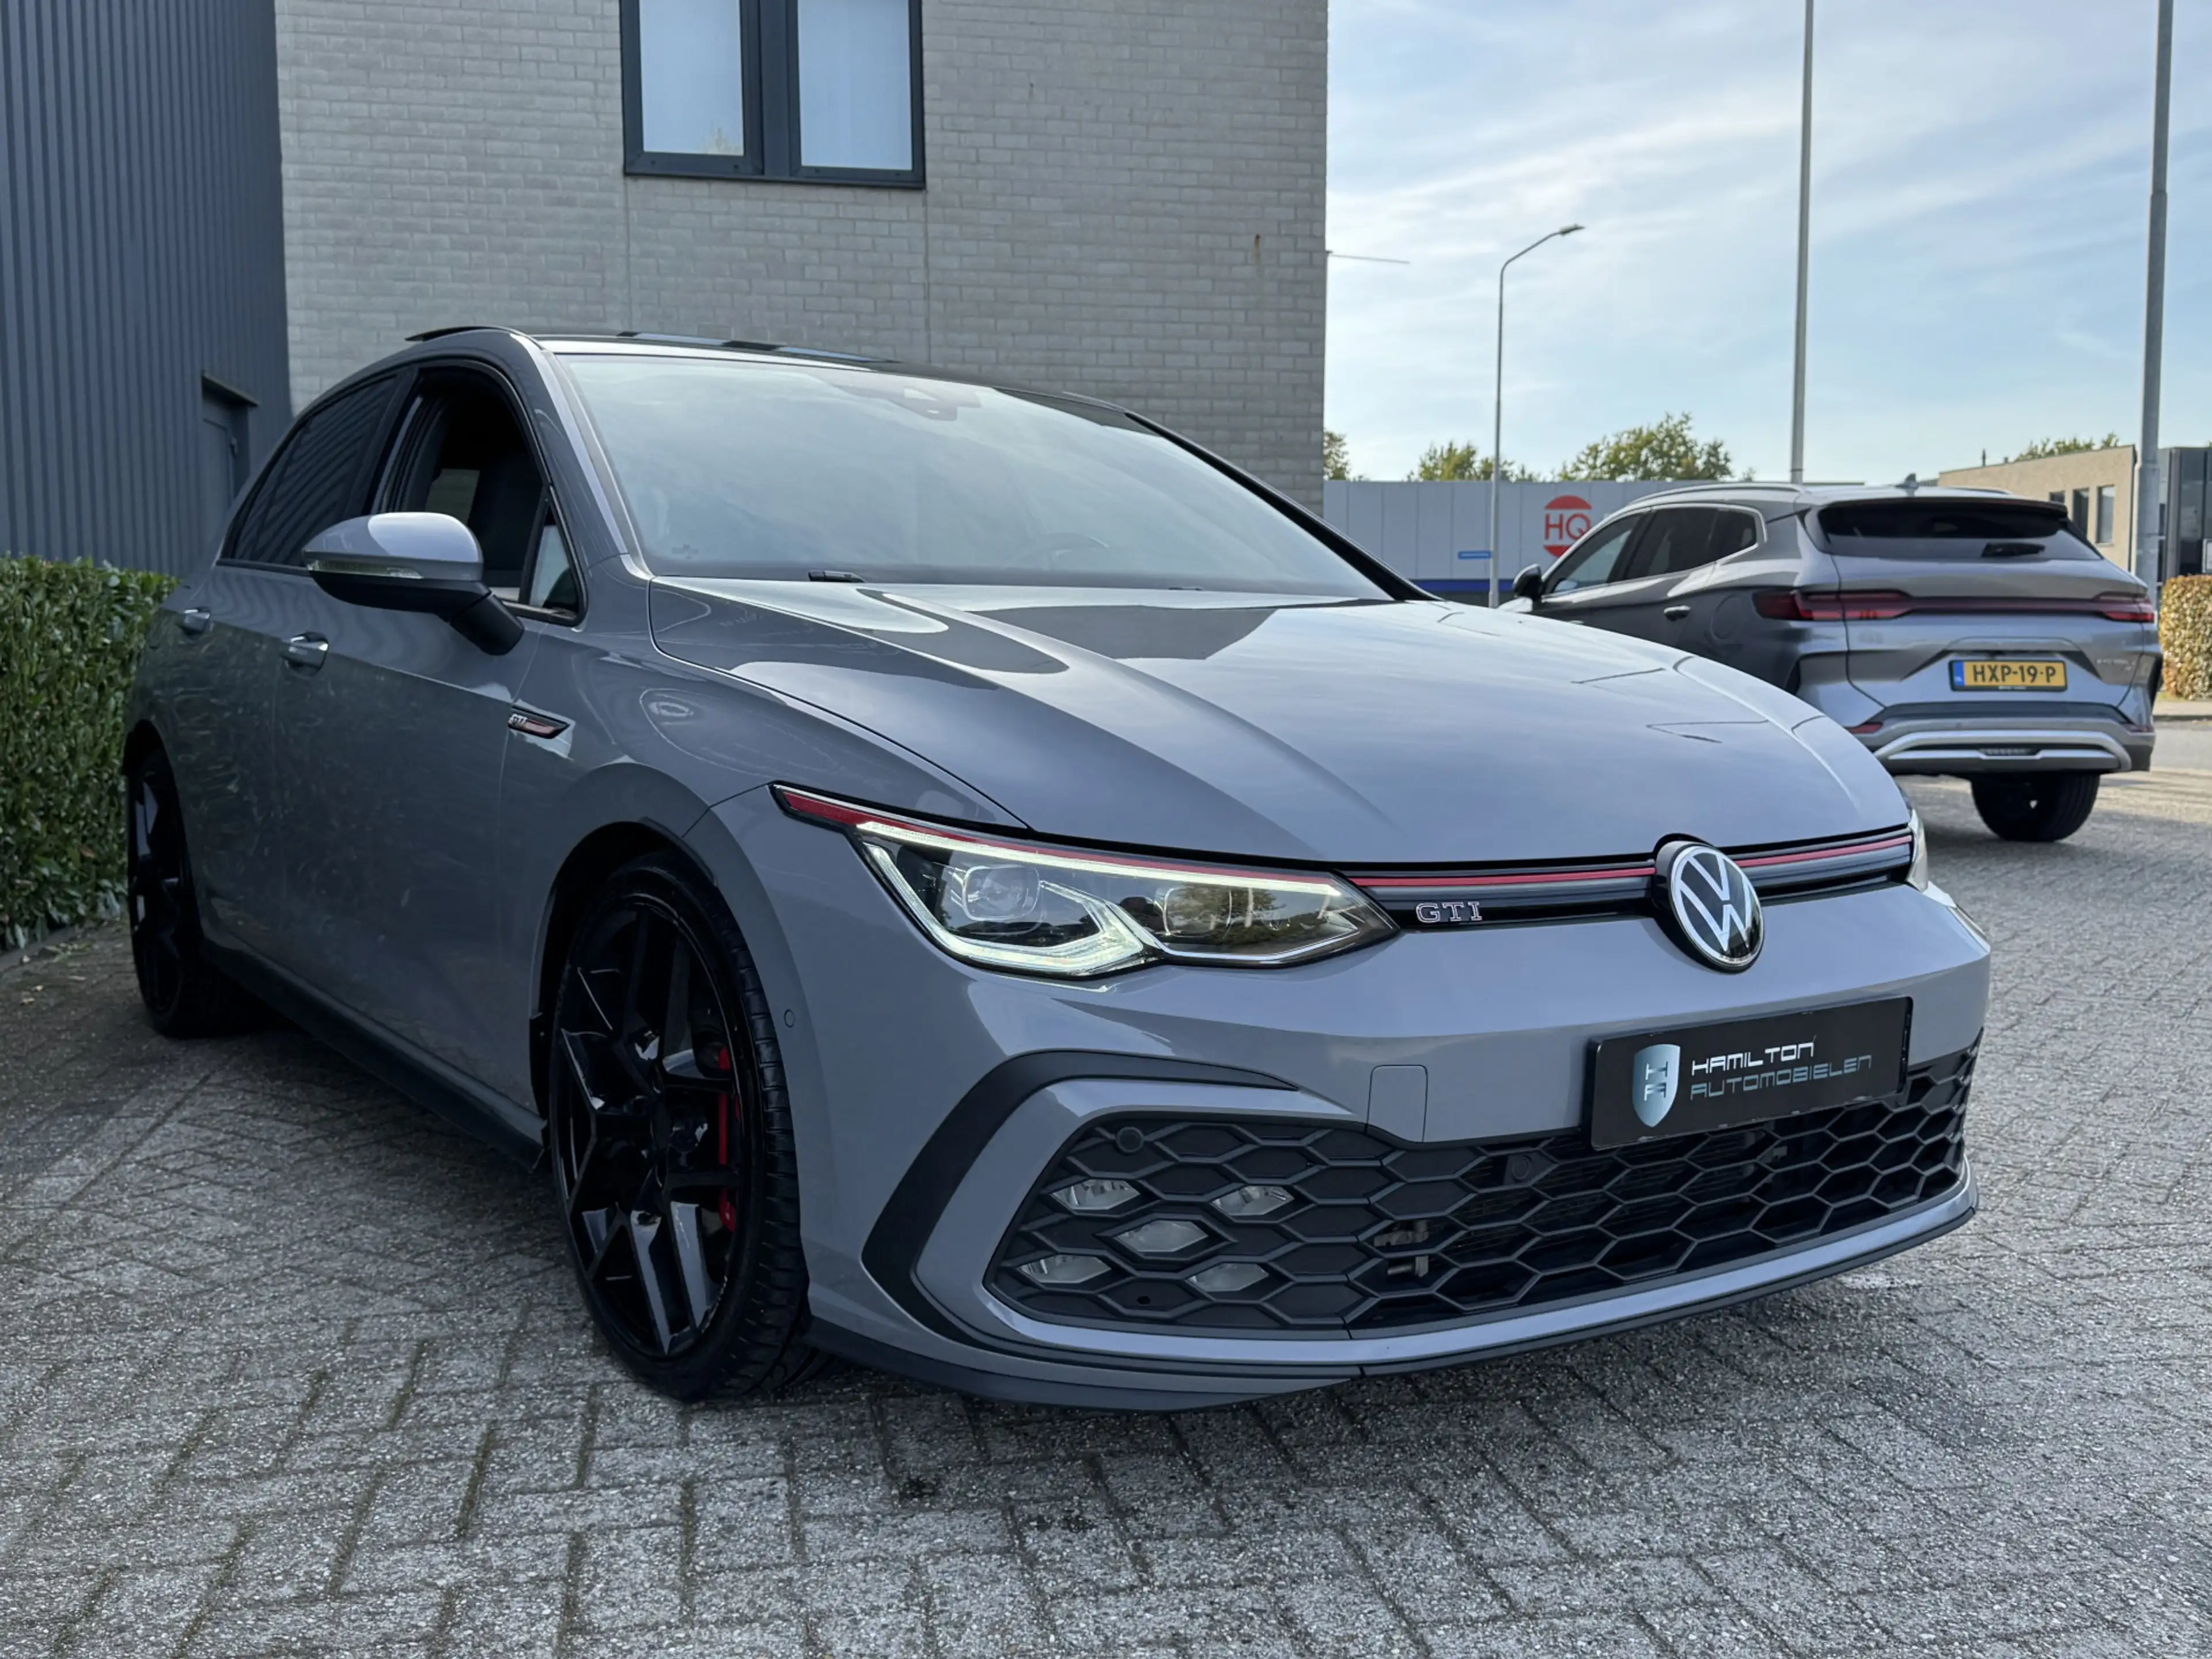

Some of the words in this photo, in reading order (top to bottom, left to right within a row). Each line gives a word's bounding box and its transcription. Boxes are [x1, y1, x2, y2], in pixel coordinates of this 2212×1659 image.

[1545, 513, 1591, 540] HQ
[1972, 665, 2056, 683] HXP-19-P
[1415, 901, 1483, 923] GTI
[1691, 1041, 1814, 1076] HAMILTON
[1690, 1054, 1872, 1100] AUTOMOBIELEN
